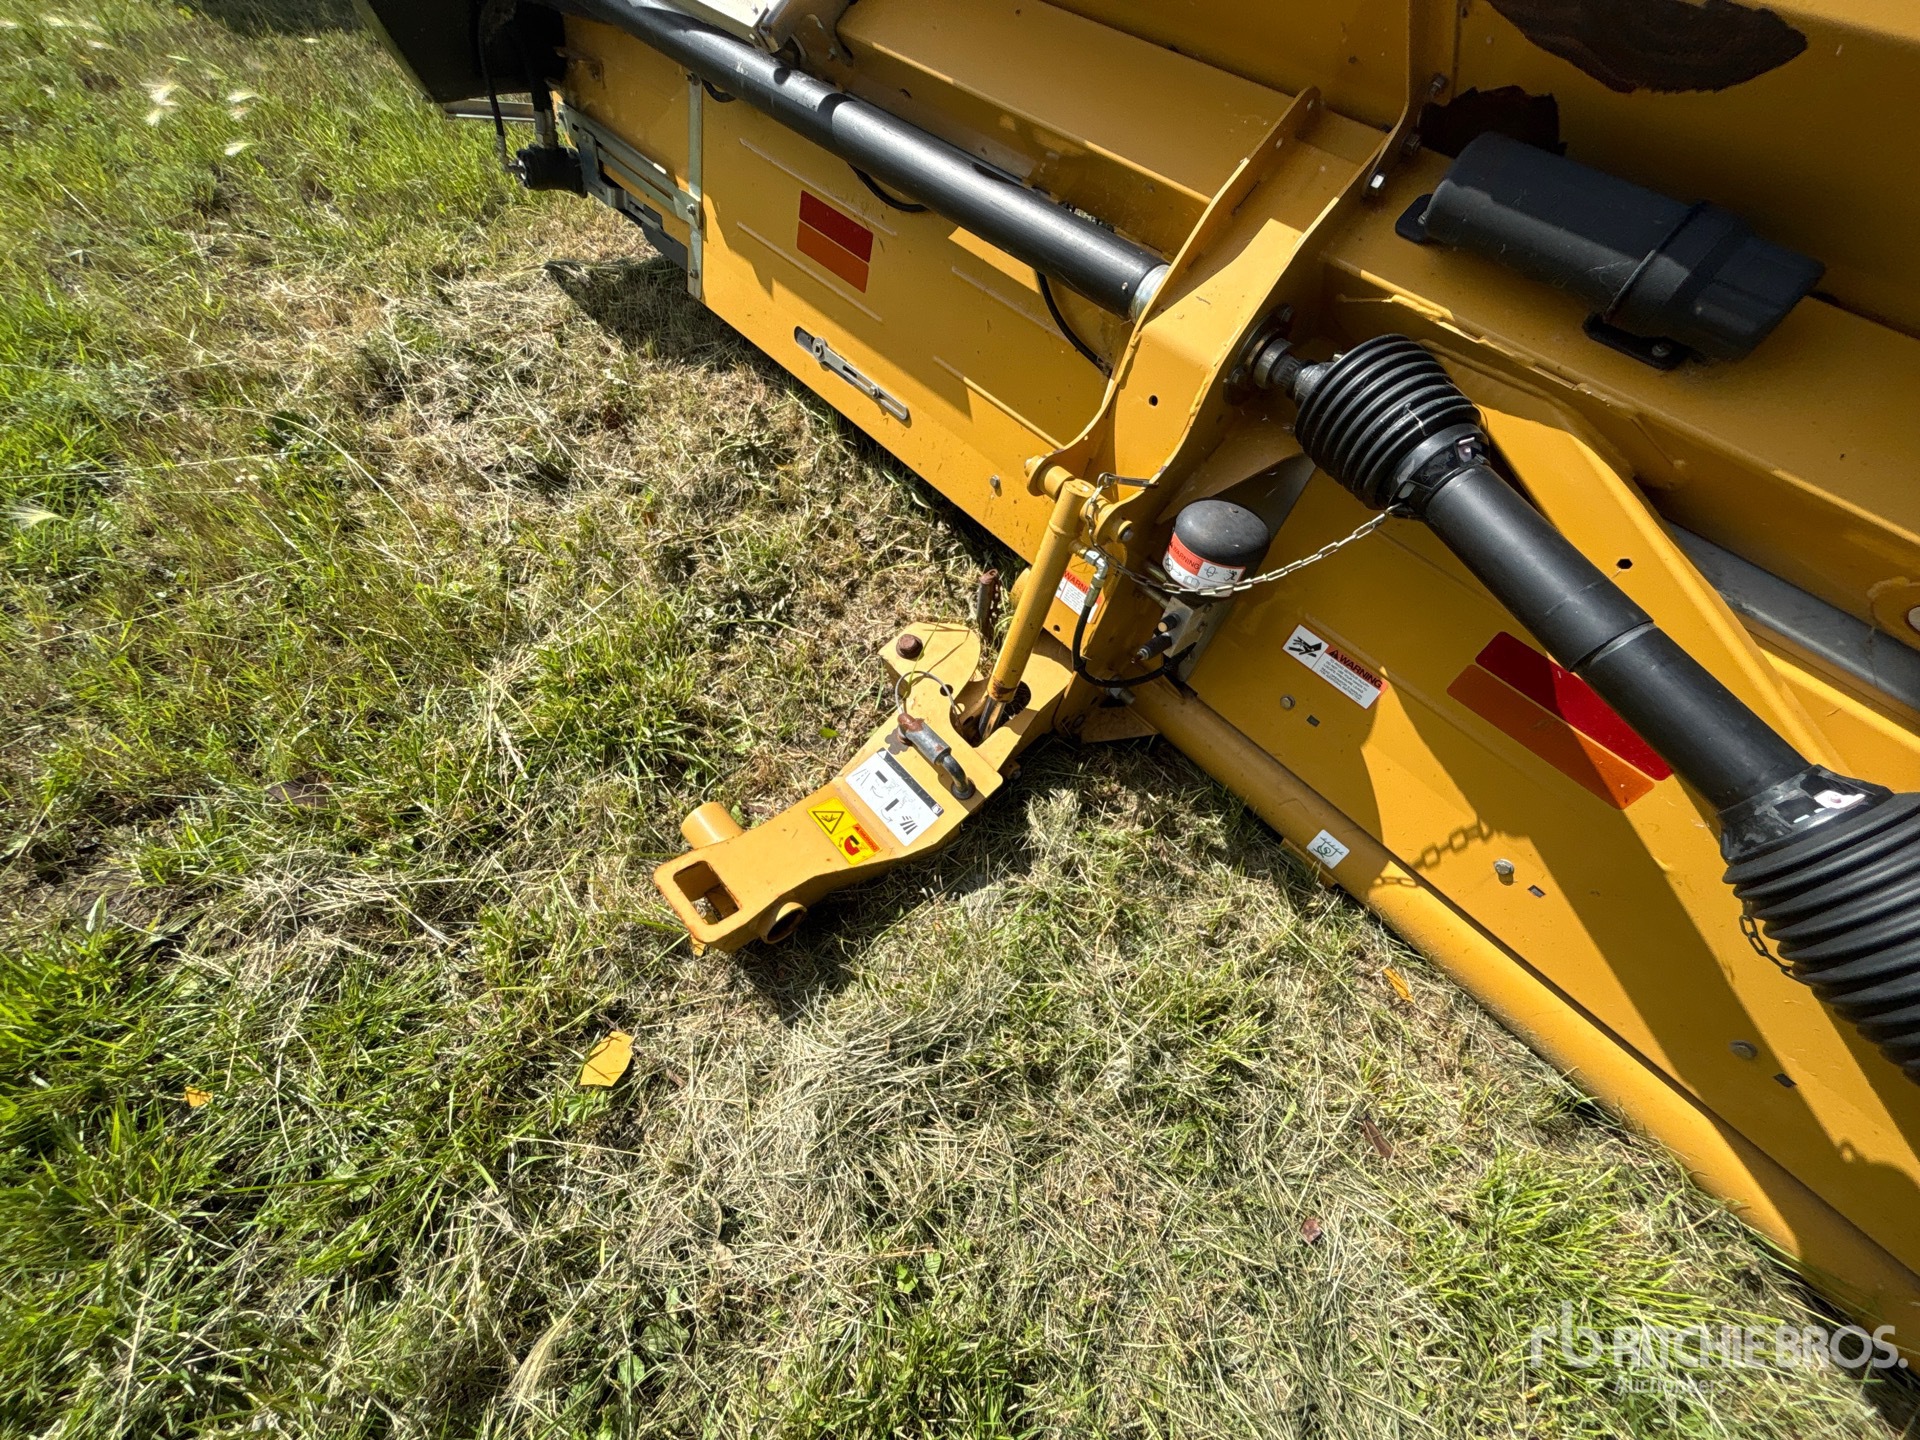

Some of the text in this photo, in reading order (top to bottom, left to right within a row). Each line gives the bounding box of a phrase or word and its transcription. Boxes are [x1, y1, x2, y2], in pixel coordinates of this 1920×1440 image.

[1173, 546, 1200, 570] WARNING
[1064, 571, 1089, 594] WARNI
[1340, 654, 1383, 689] WARNING
